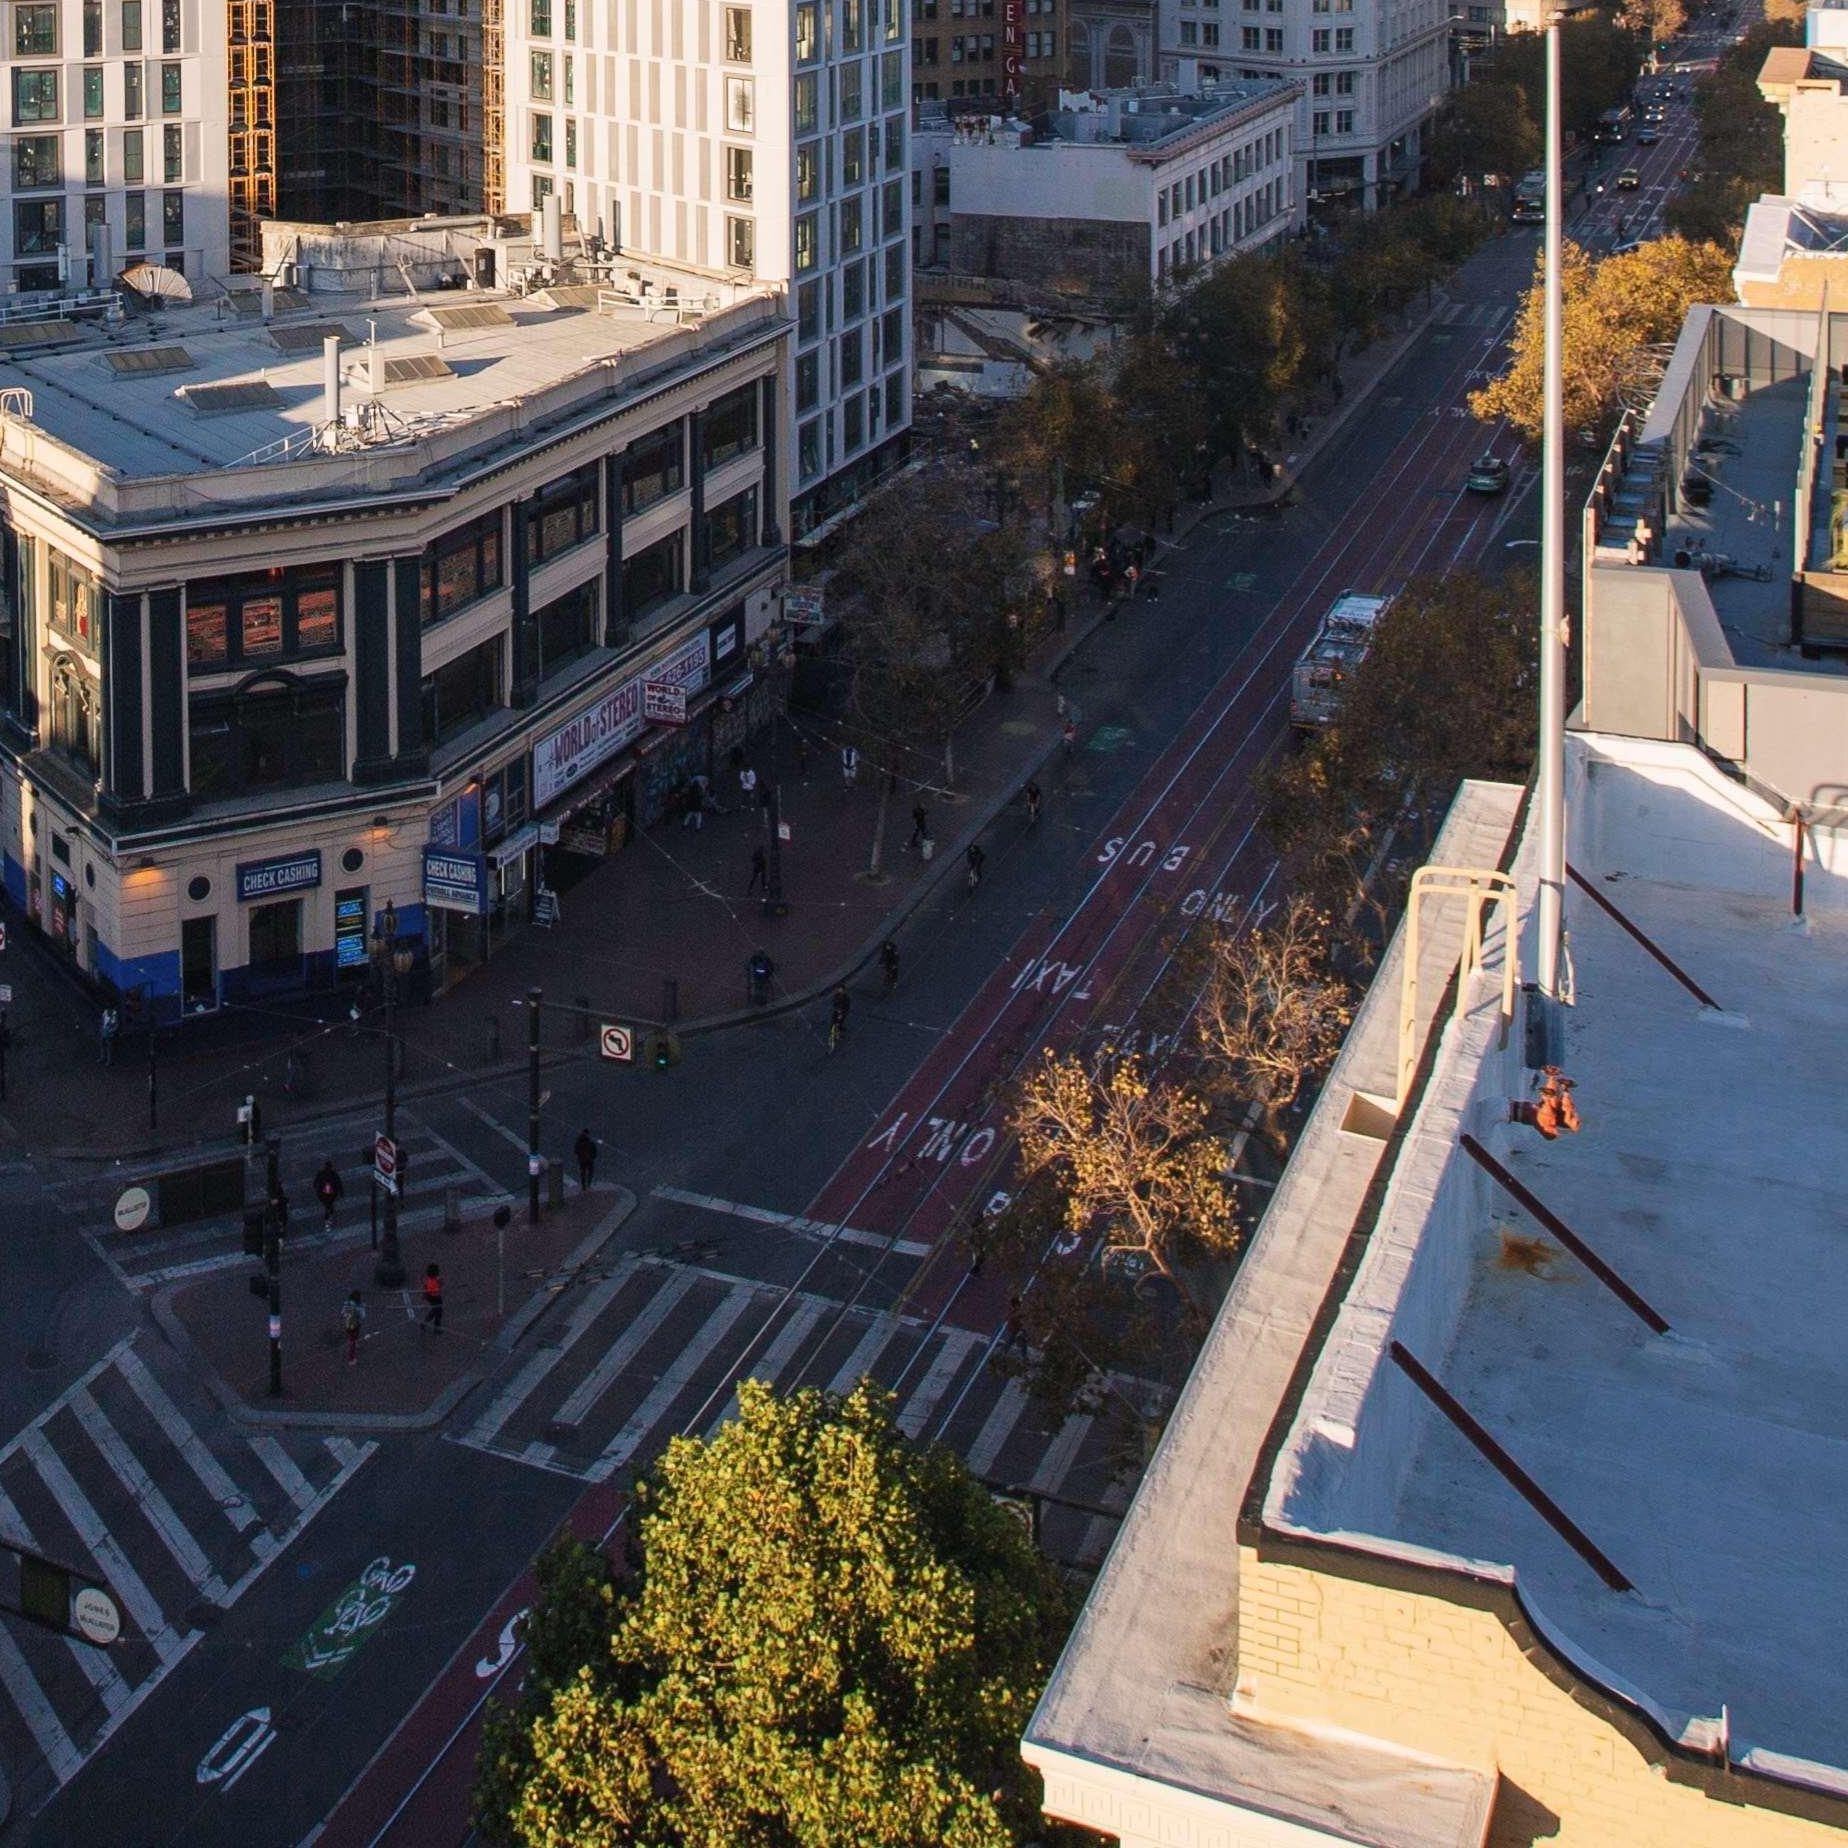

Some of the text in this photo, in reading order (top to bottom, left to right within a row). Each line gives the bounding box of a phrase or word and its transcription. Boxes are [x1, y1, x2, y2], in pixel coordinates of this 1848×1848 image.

[647, 684, 679, 696] WORLD
[646, 703, 681, 714] STEREO
[554, 714, 591, 769] WORLD
[599, 683, 638, 737] STEREO
[1098, 837, 1190, 870] BUS
[243, 862, 319, 892] CHECK CASHING
[426, 859, 477, 883] CHECK CASHING
[1180, 889, 1279, 925] ONLY
[1011, 958, 1091, 1000] TAXI
[867, 1112, 996, 1166] ONLY
